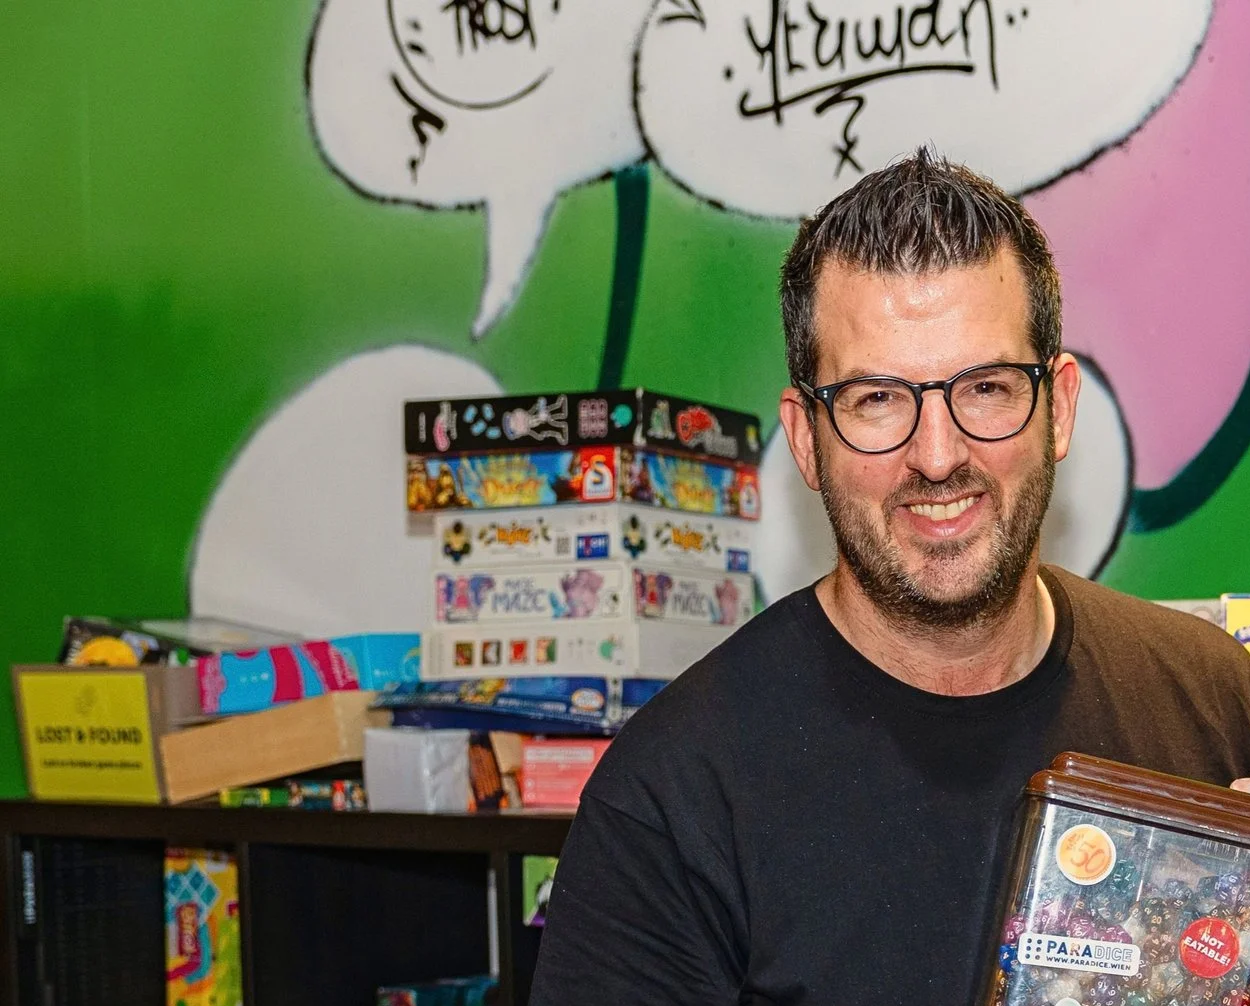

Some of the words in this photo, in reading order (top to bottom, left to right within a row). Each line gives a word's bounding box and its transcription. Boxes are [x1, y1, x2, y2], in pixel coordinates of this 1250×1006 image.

[37, 726, 71, 744] LOST
[90, 726, 142, 745] FOUND
[1200, 932, 1225, 949] NOT
[1046, 940, 1133, 962] PARADICE
[1184, 936, 1231, 967] EATABLE!
[1046, 956, 1131, 971] WWW.PARADICE.WIEN
